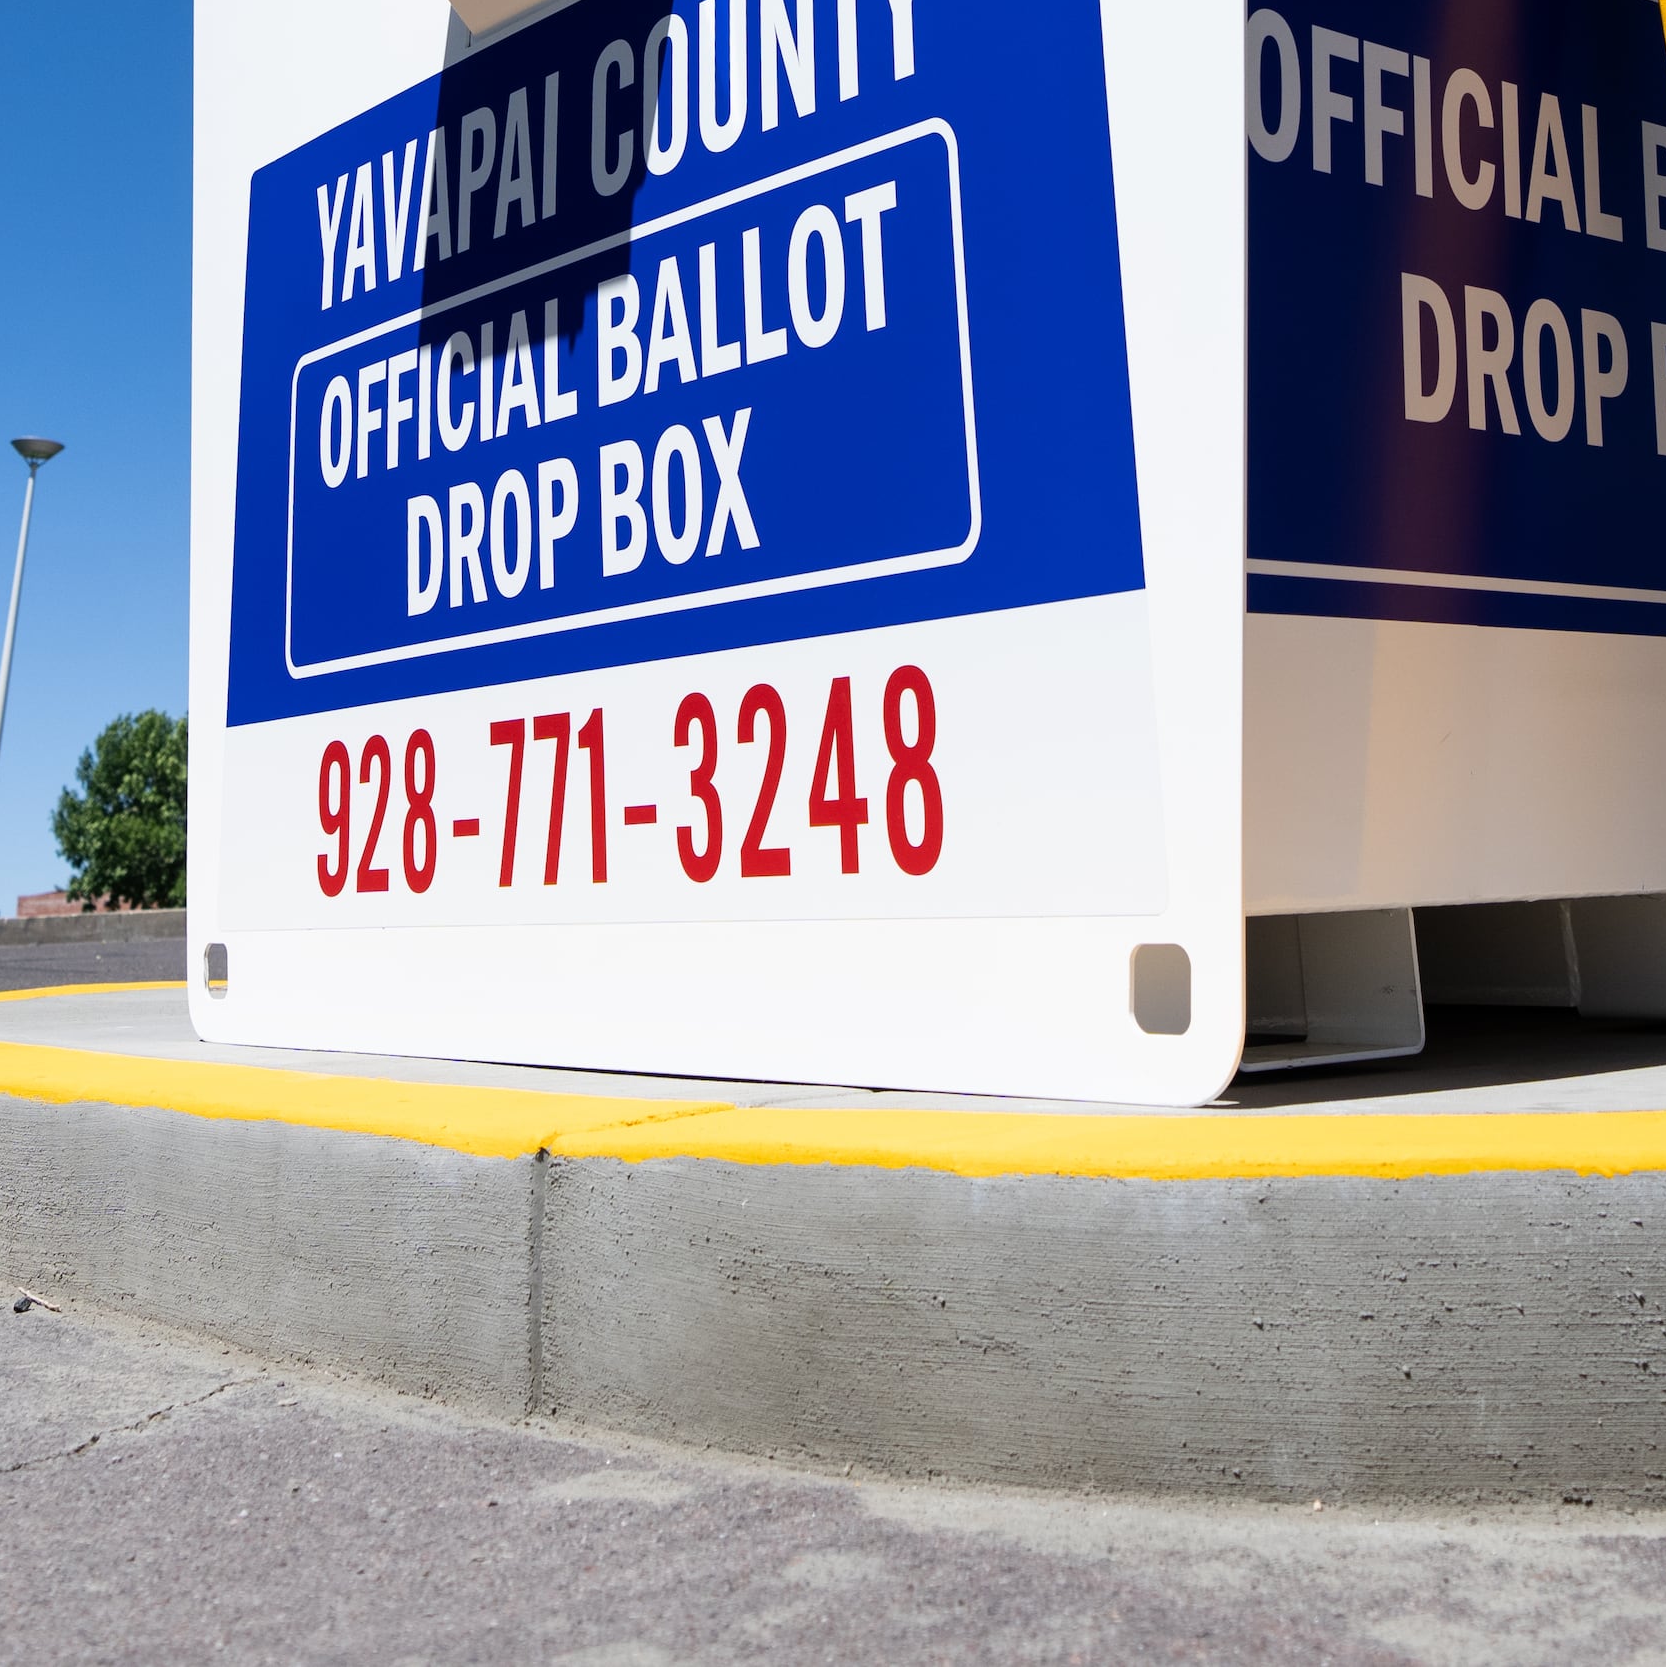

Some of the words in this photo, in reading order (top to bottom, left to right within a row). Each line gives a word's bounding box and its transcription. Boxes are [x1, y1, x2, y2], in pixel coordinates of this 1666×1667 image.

[316, 71, 560, 312] YAVAPAI
[1246, 7, 1624, 242] OFFICIAL
[319, 297, 578, 489] OFFICIAL
[596, 179, 898, 408] BALLOT
[1400, 271, 1629, 447] DROP
[406, 457, 580, 617] DROP
[599, 406, 761, 578] BOX
[317, 664, 944, 898] 928-771-3248
